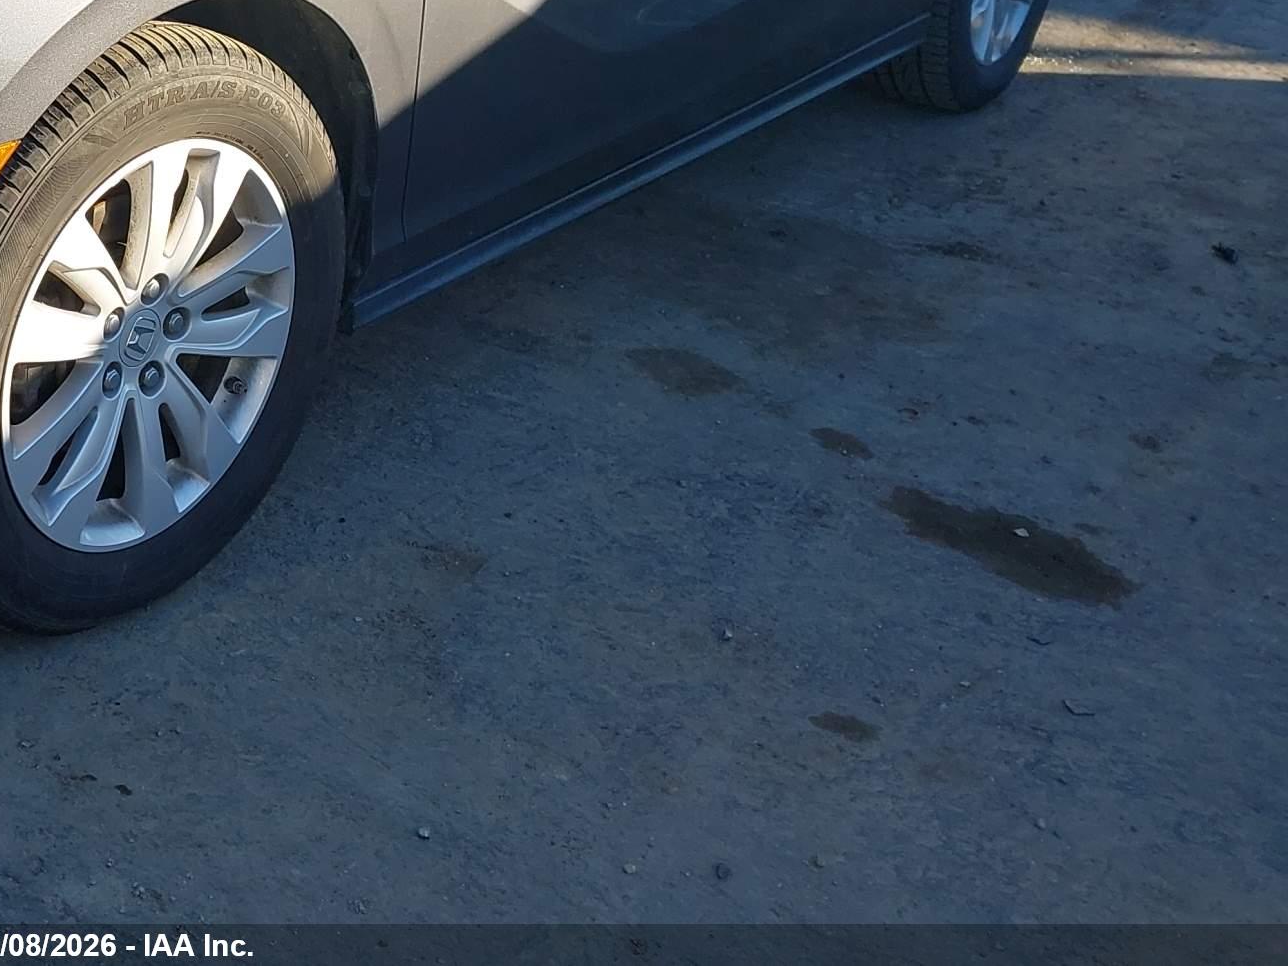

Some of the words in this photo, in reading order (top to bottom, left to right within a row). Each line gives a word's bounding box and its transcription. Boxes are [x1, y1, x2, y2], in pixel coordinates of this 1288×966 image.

[123, 85, 186, 130] HTR
[190, 80, 238, 99] A/S
[242, 85, 287, 118] P03
